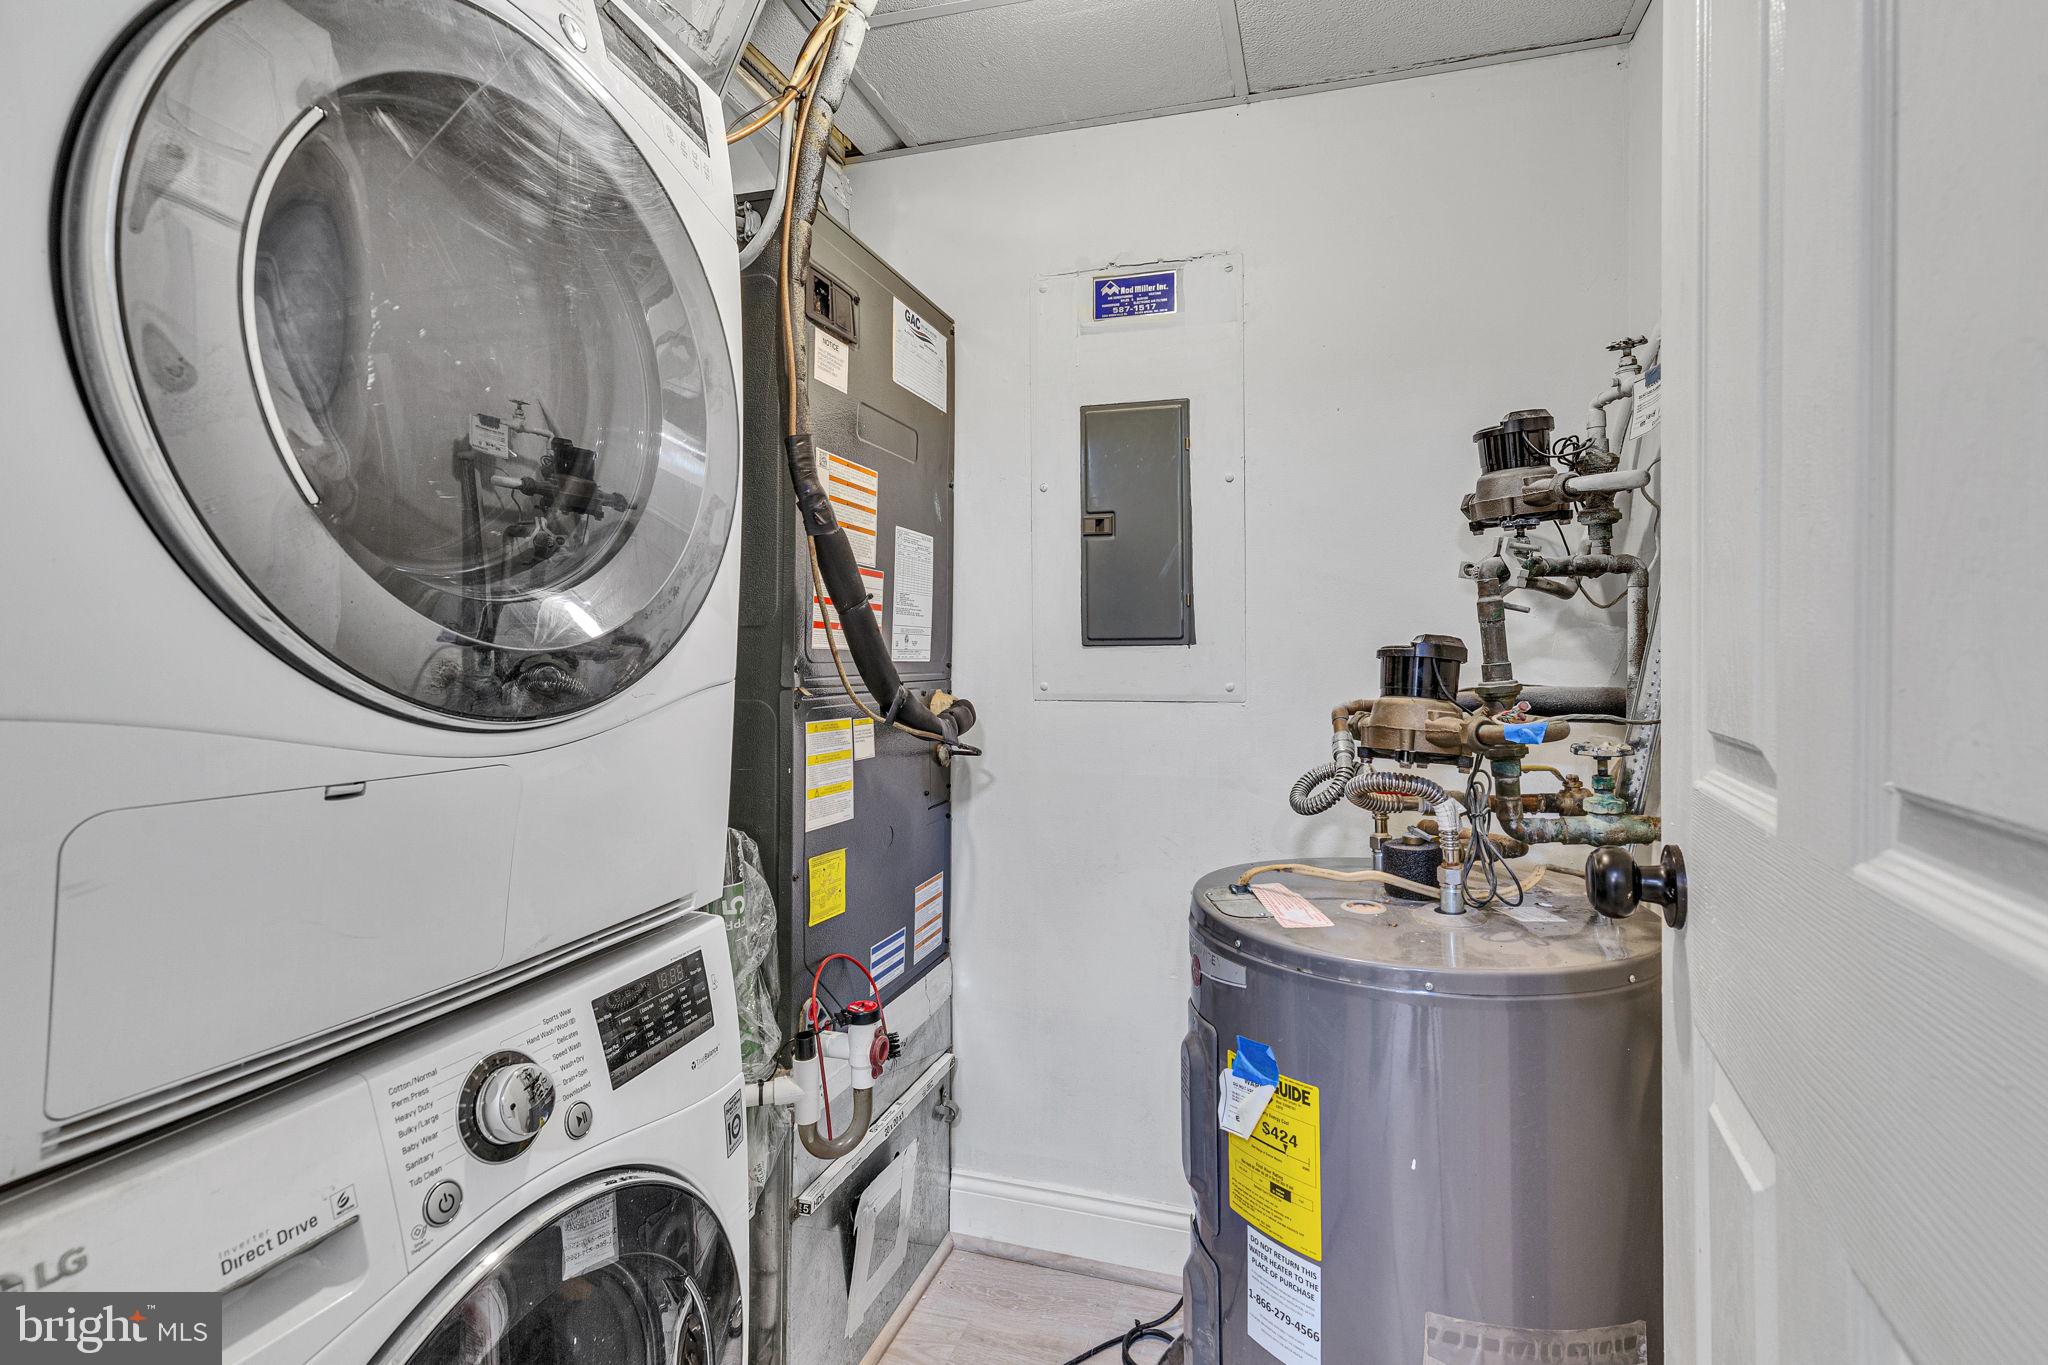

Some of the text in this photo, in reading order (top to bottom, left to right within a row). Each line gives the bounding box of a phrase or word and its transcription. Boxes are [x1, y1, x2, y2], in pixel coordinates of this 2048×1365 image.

[1134, 284, 1155, 293] Miller
[904, 309, 920, 330] GAC
[1112, 303, 1156, 314] 587-1517
[822, 338, 839, 352] NOTICE
[542, 1008, 572, 1025] Sports Wear
[526, 1021, 569, 1045] Hand Wash/Wool
[556, 1030, 578, 1045] Delicates
[552, 1041, 581, 1061] Speed Wash
[560, 1055, 584, 1071] Wash+Dry
[388, 1068, 437, 1096] Cotton/Normal
[562, 1068, 588, 1086] Drain+Spin
[562, 1081, 592, 1102] Downloaded
[395, 1101, 433, 1124] Heavy Duty
[398, 1114, 439, 1138] Bulky/Large
[728, 1113, 741, 1145] 10
[1262, 1122, 1298, 1148] $424
[402, 1131, 438, 1155] Baby Wear
[405, 1152, 434, 1171] Sanitary
[409, 1166, 442, 1188] Tub Clean
[802, 1204, 809, 1214] 5
[218, 1229, 270, 1260] Inverter
[221, 1216, 318, 1276] Direct Drive
[34, 1246, 88, 1290] LG
[1249, 1244, 1319, 1292] WATER HEATER TO THE
[1250, 1235, 1317, 1280] DO NOT RETURN THIS
[1252, 1257, 1315, 1301] PLACE OF PURCHASE
[1248, 1288, 1320, 1342] 1-866-279-4566
